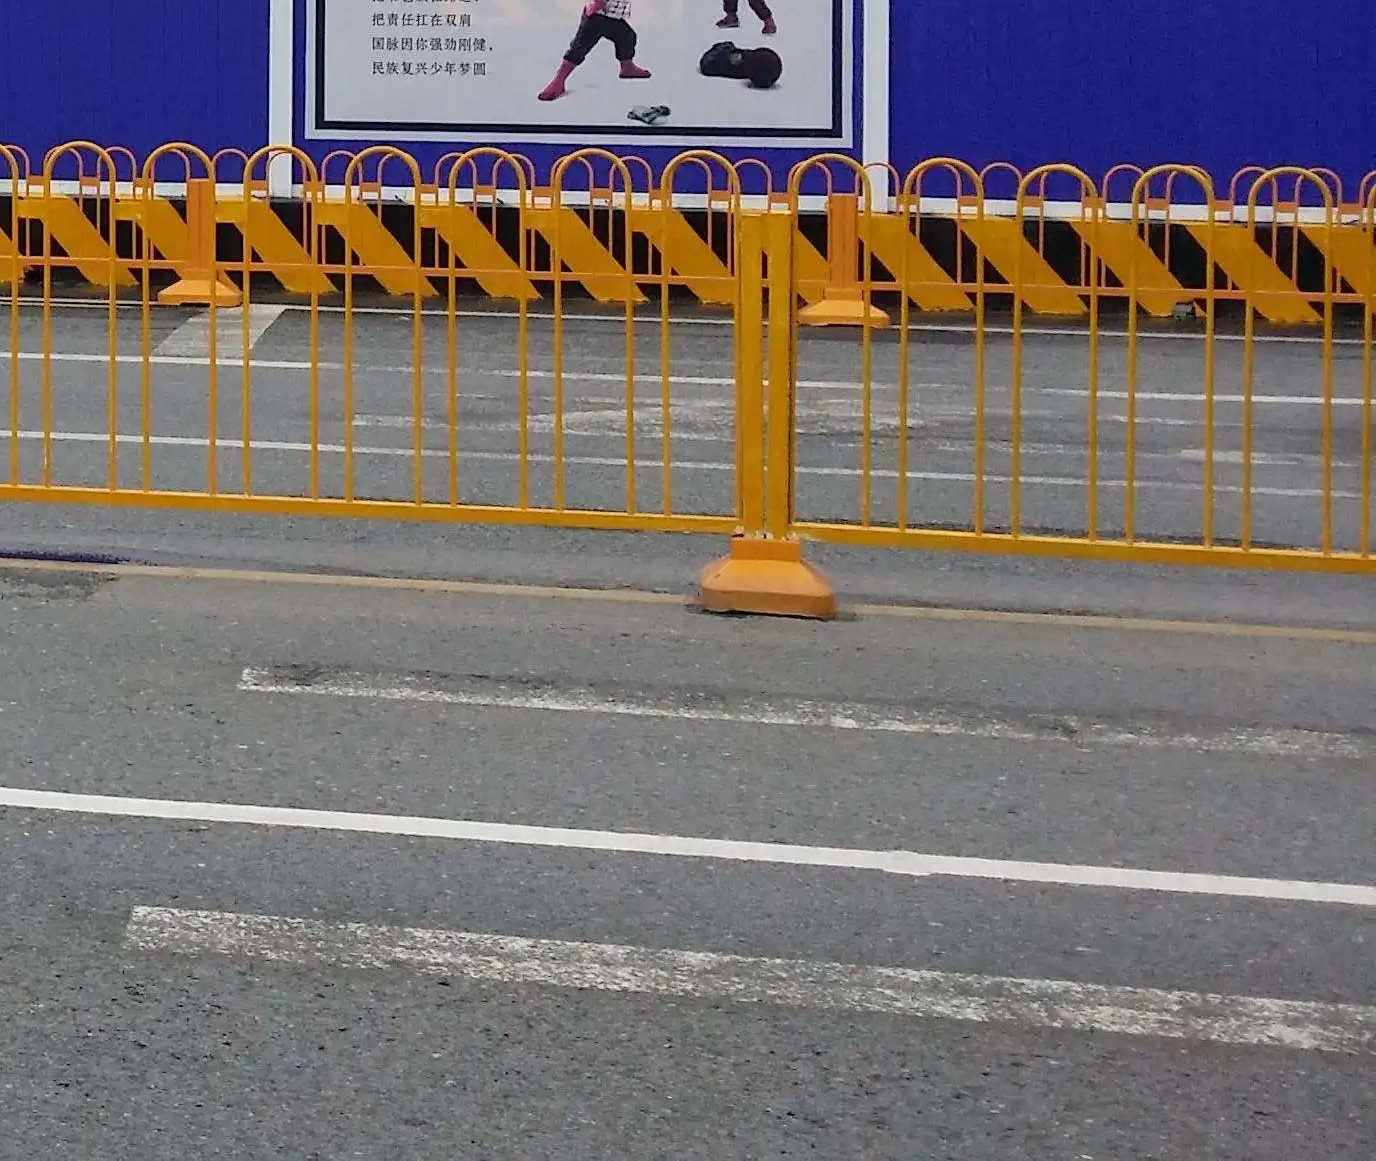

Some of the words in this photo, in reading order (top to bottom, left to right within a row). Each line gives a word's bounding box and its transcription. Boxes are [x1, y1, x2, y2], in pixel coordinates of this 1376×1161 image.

[372, 13, 471, 27] 把责任扛在双肩
[372, 61, 486, 75] 民族复兴少年梦圆
